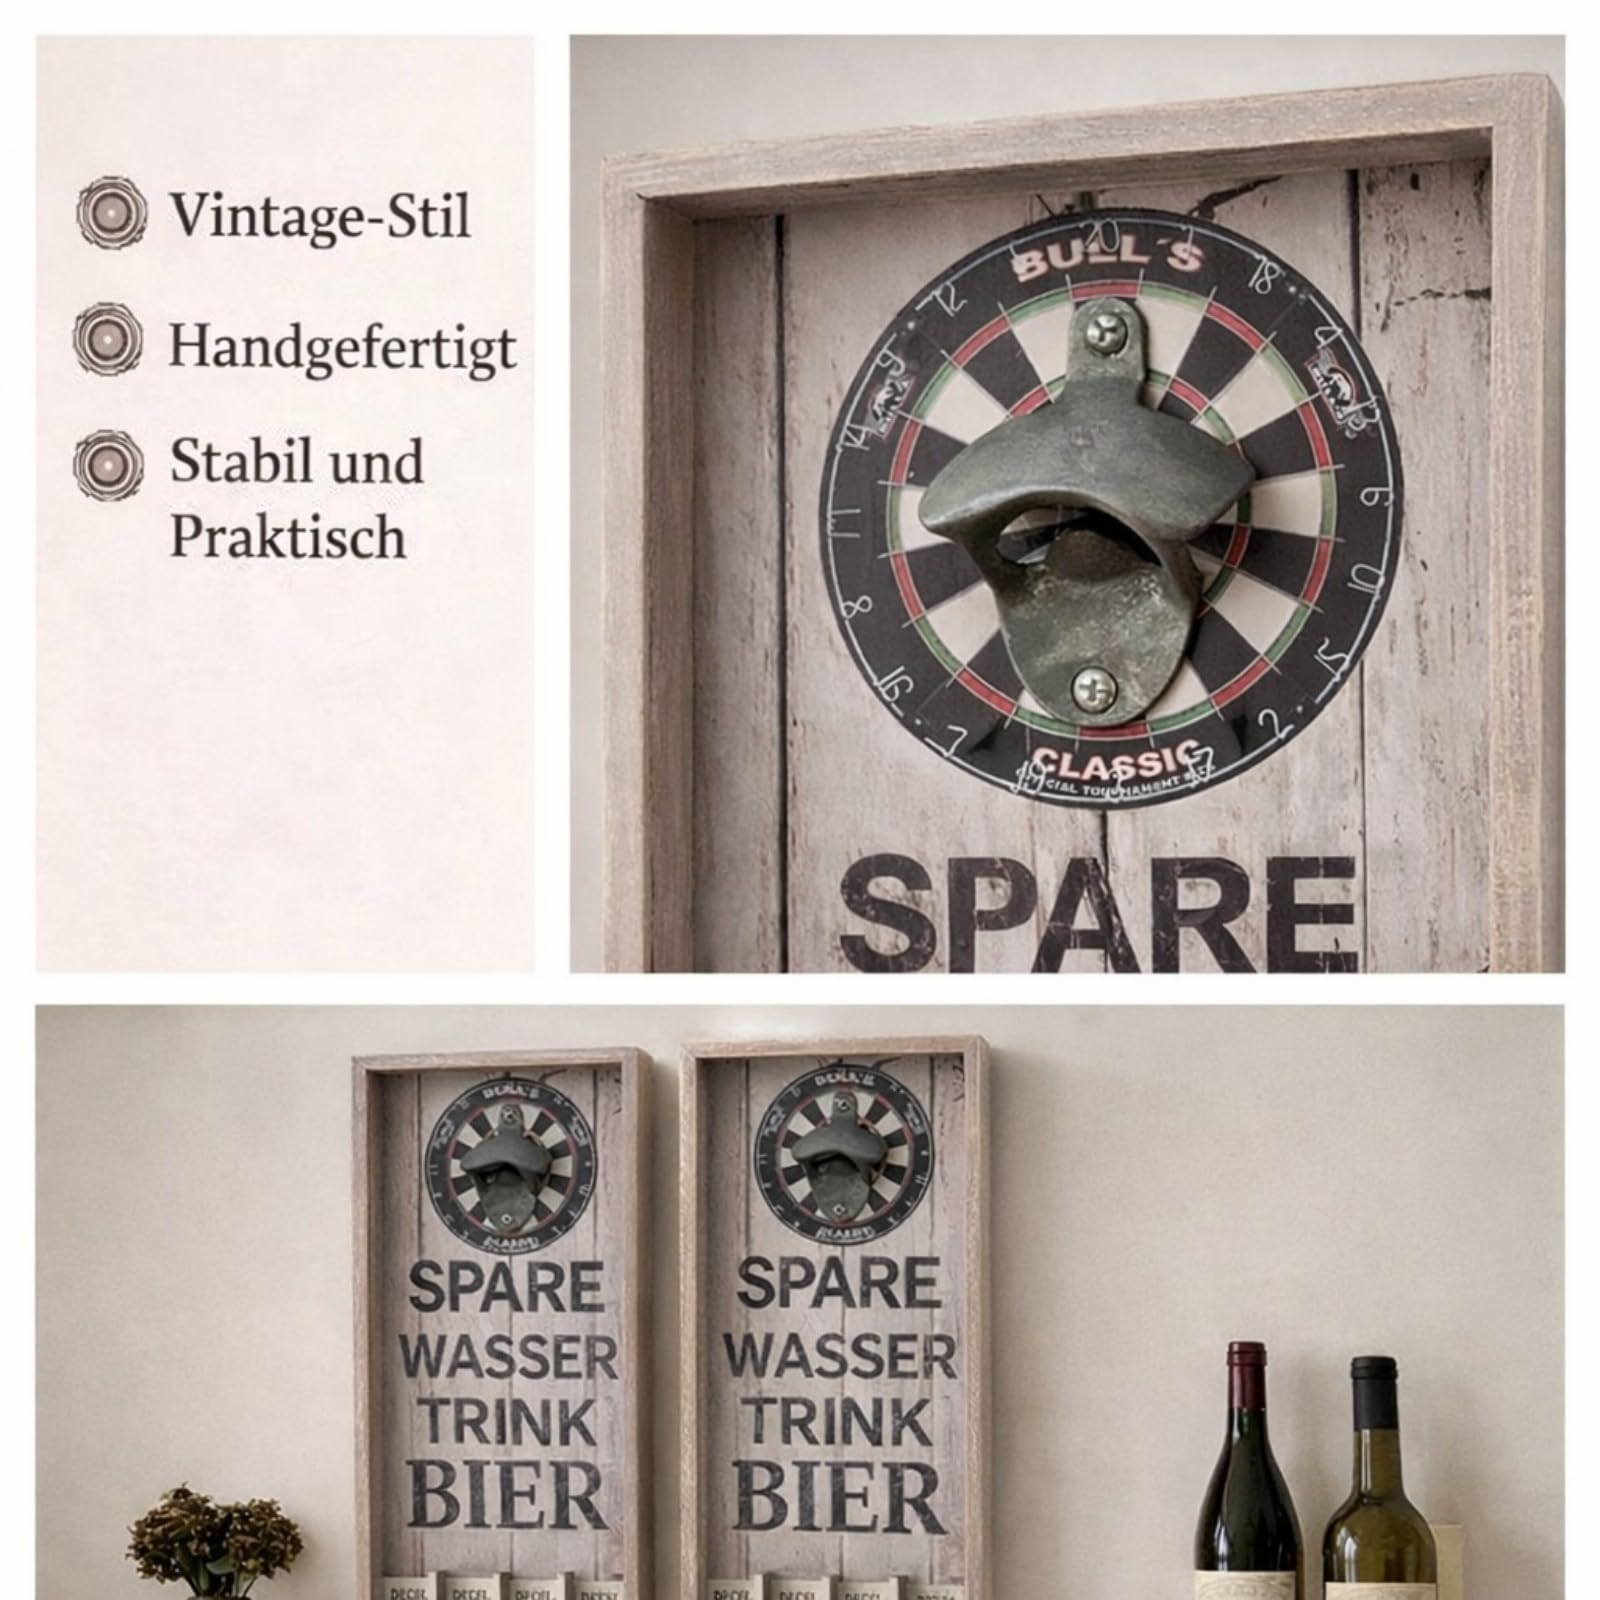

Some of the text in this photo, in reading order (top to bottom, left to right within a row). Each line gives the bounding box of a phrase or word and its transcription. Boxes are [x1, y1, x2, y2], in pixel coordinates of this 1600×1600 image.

[1031, 738, 1201, 782] CLASSIC
[840, 853, 1358, 973] SPARE
[408, 1259, 605, 1313] SPARE
[736, 1255, 943, 1309] SPARE
[398, 1333, 619, 1380] WASSER
[722, 1332, 958, 1380] WASSER
[416, 1396, 598, 1447] TRINK
[740, 1396, 934, 1447] TRINK
[405, 1459, 610, 1530] BIER
[731, 1459, 948, 1535] BIER
